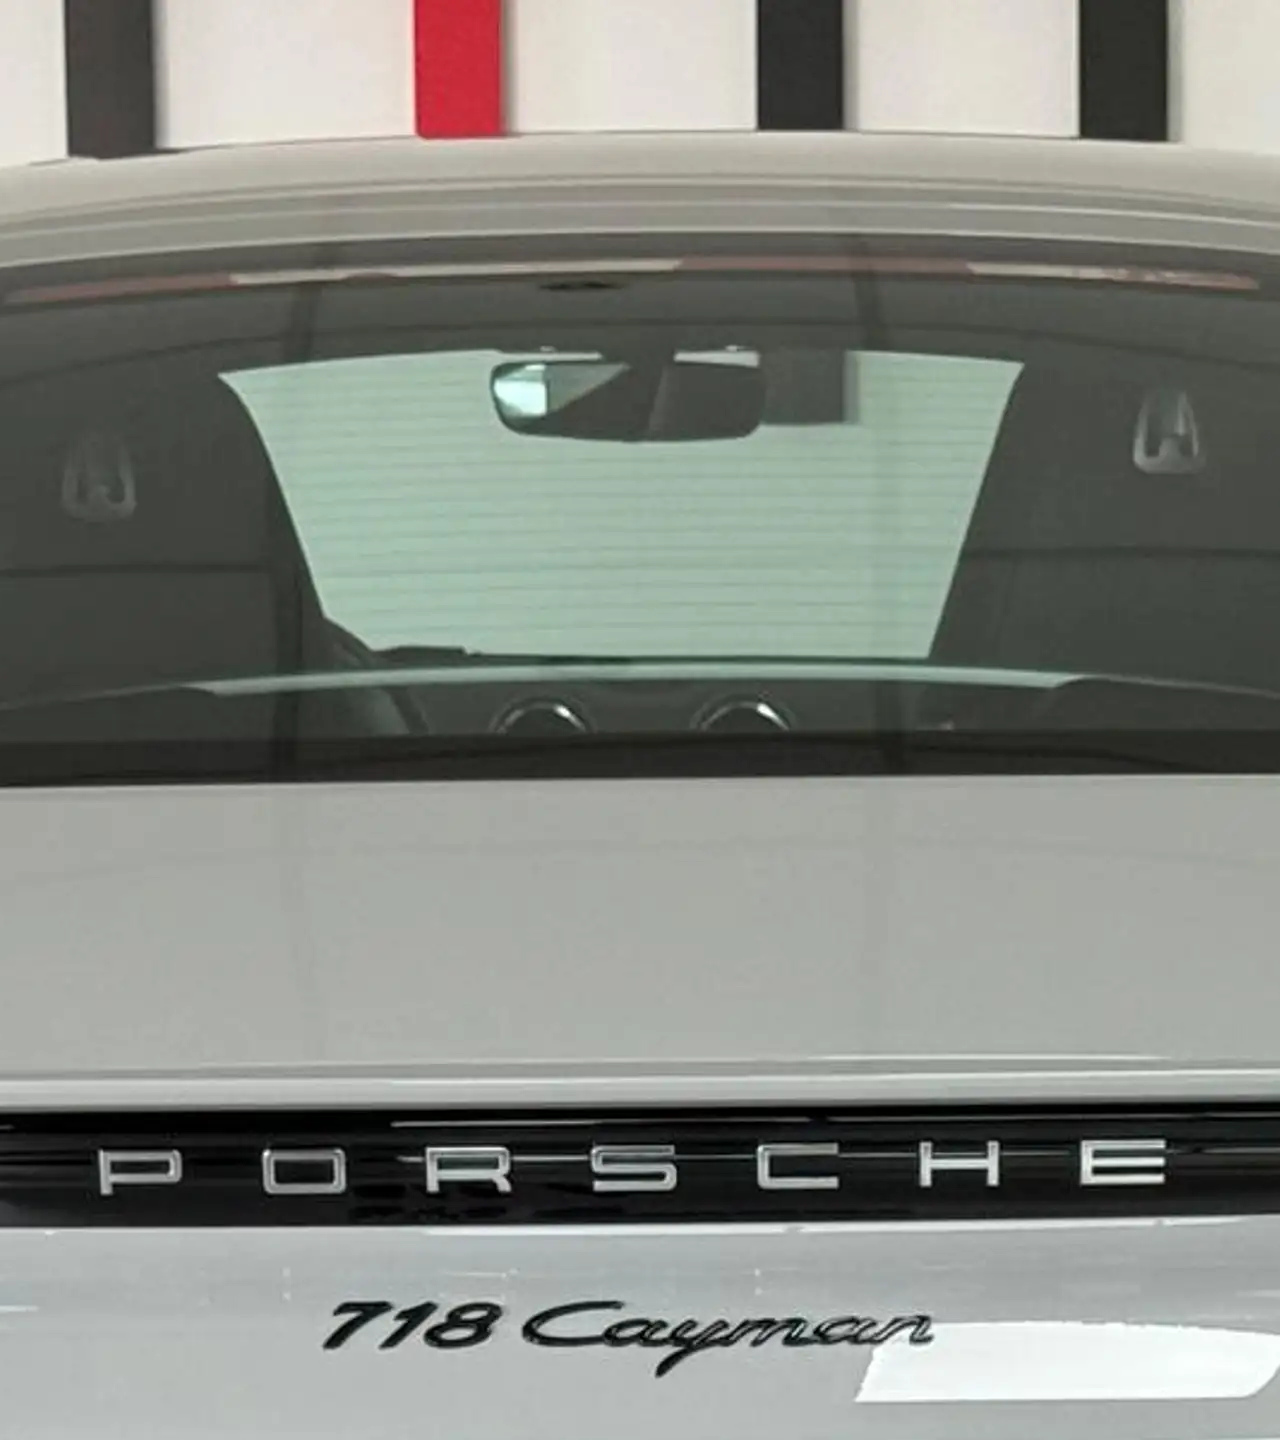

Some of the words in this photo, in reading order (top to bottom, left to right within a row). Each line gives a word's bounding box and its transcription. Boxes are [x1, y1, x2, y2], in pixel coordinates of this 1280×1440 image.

[98, 1138, 1168, 1196] PORSCHE
[323, 1303, 503, 1350] 718
[522, 1302, 934, 1378] Cayman
